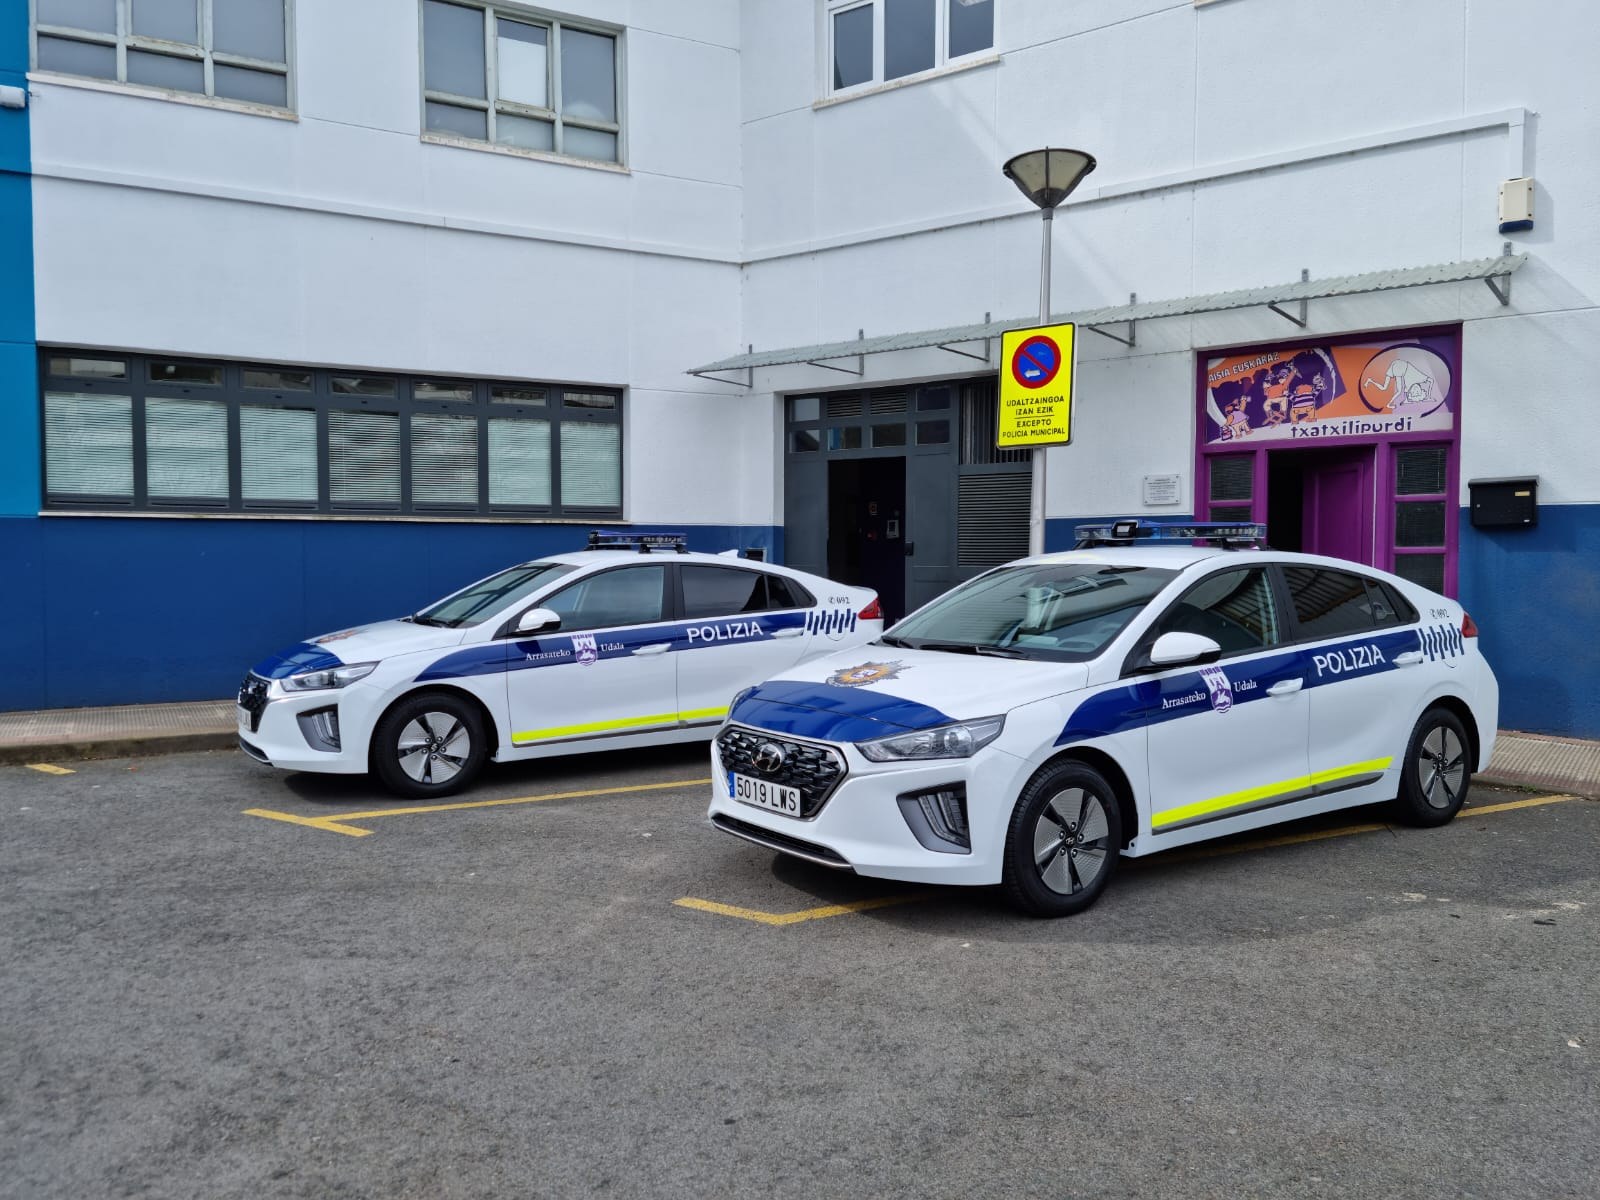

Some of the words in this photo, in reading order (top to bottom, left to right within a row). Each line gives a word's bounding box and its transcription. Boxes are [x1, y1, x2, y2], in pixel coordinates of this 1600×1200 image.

[1232, 351, 1280, 374] EUSKARAZ
[1006, 395, 1065, 407] UDALTZAINGOA
[1016, 408, 1034, 416] IZAN
[1036, 406, 1054, 414] EZIK
[1002, 430, 1028, 438] POLICIA
[1030, 427, 1066, 436] MUNICIPAL
[1016, 418, 1052, 428] EXCEPTO
[1291, 417, 1412, 438] txatxilipurdi
[686, 621, 763, 643] POLIZIA
[526, 649, 571, 661] Arrasateko
[600, 642, 625, 652] Udala
[1312, 643, 1386, 677] POLIZIA
[1161, 690, 1207, 710] Arrasateko
[1234, 678, 1258, 692] Udala
[737, 776, 767, 804] 5019
[771, 785, 797, 812] LWS
